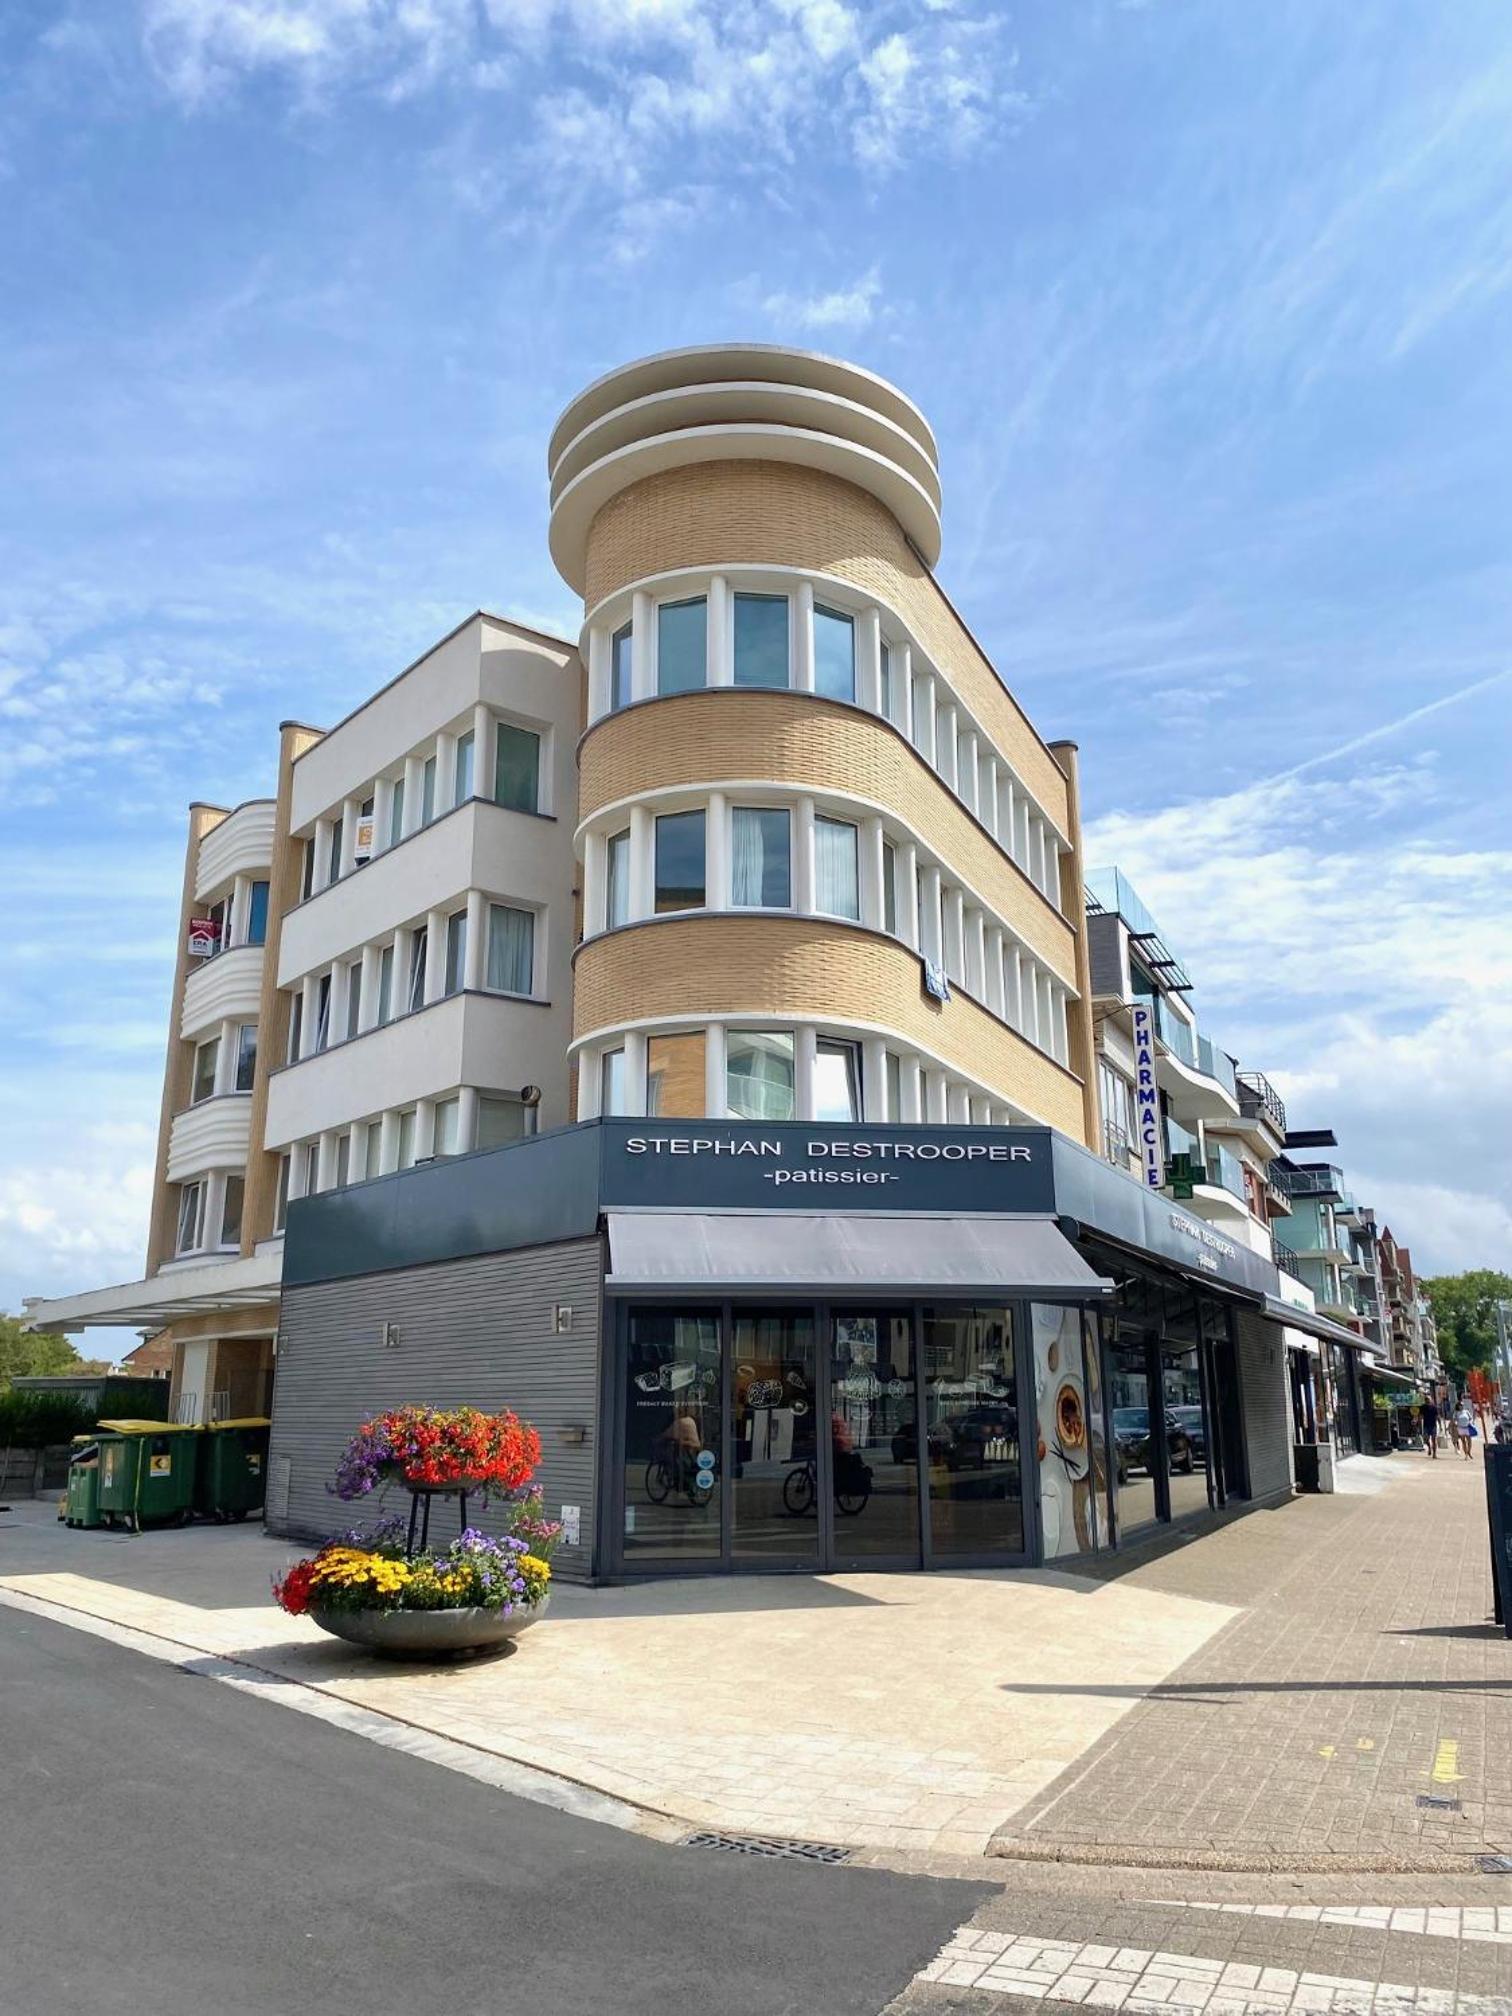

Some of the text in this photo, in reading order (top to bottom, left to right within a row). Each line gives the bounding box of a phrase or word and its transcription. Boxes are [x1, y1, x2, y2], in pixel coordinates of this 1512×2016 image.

[1134, 1011, 1159, 1186] PHARMACIE
[626, 1137, 1032, 1162] STEPHAN DESTROOPER
[763, 1167, 900, 1186] -patissier-
